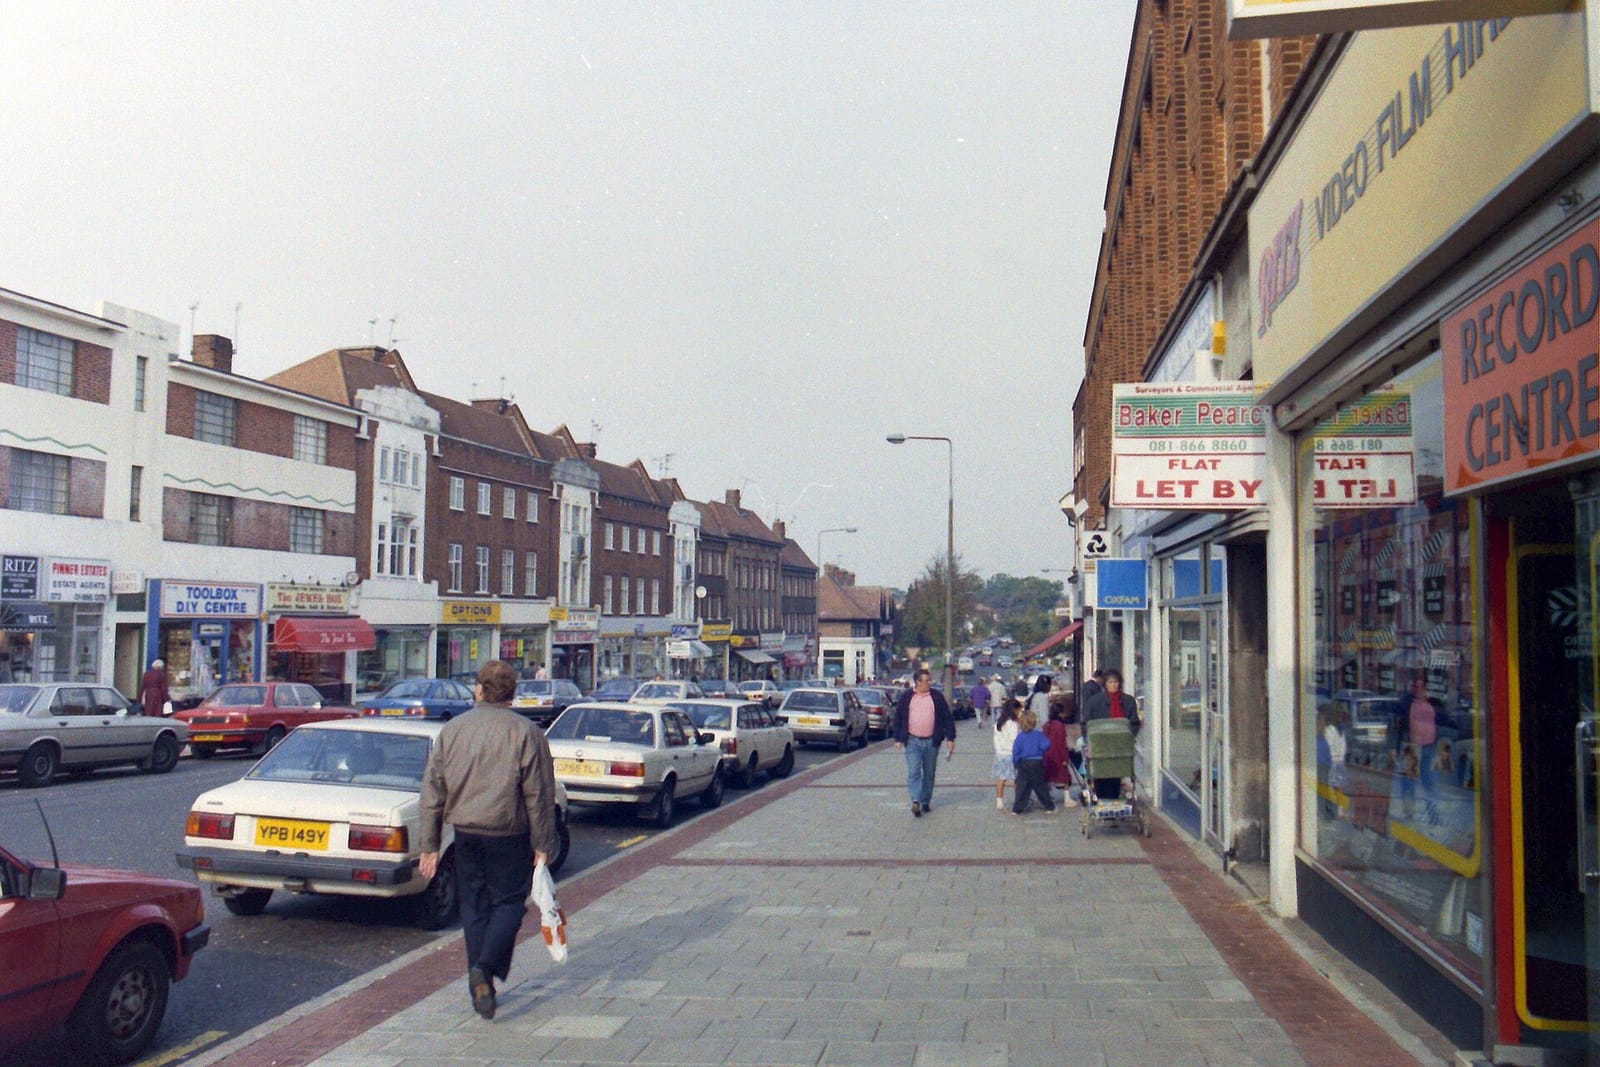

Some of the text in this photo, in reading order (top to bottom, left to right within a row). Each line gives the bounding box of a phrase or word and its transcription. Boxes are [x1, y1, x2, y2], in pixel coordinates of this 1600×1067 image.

[1314, 140, 1368, 241] VIDEO
[1376, 55, 1433, 174] FILM
[1460, 243, 1600, 385] RECORD
[1135, 386, 1174, 395] Surveyors
[1119, 401, 1264, 428] Baker Pearc
[1465, 353, 1600, 473] CENTRE
[1211, 439, 1247, 451] 8860
[1168, 459, 1221, 470] FLAT
[1136, 480, 1263, 498] LET BY
[4, 558, 36, 572] RITZ
[186, 587, 238, 600] TOOLBOX
[1104, 596, 1140, 604] OXFAM
[205, 602, 247, 613] CENTRE
[452, 606, 492, 615] OPTIONS
[259, 825, 326, 844] YPB 149Y
